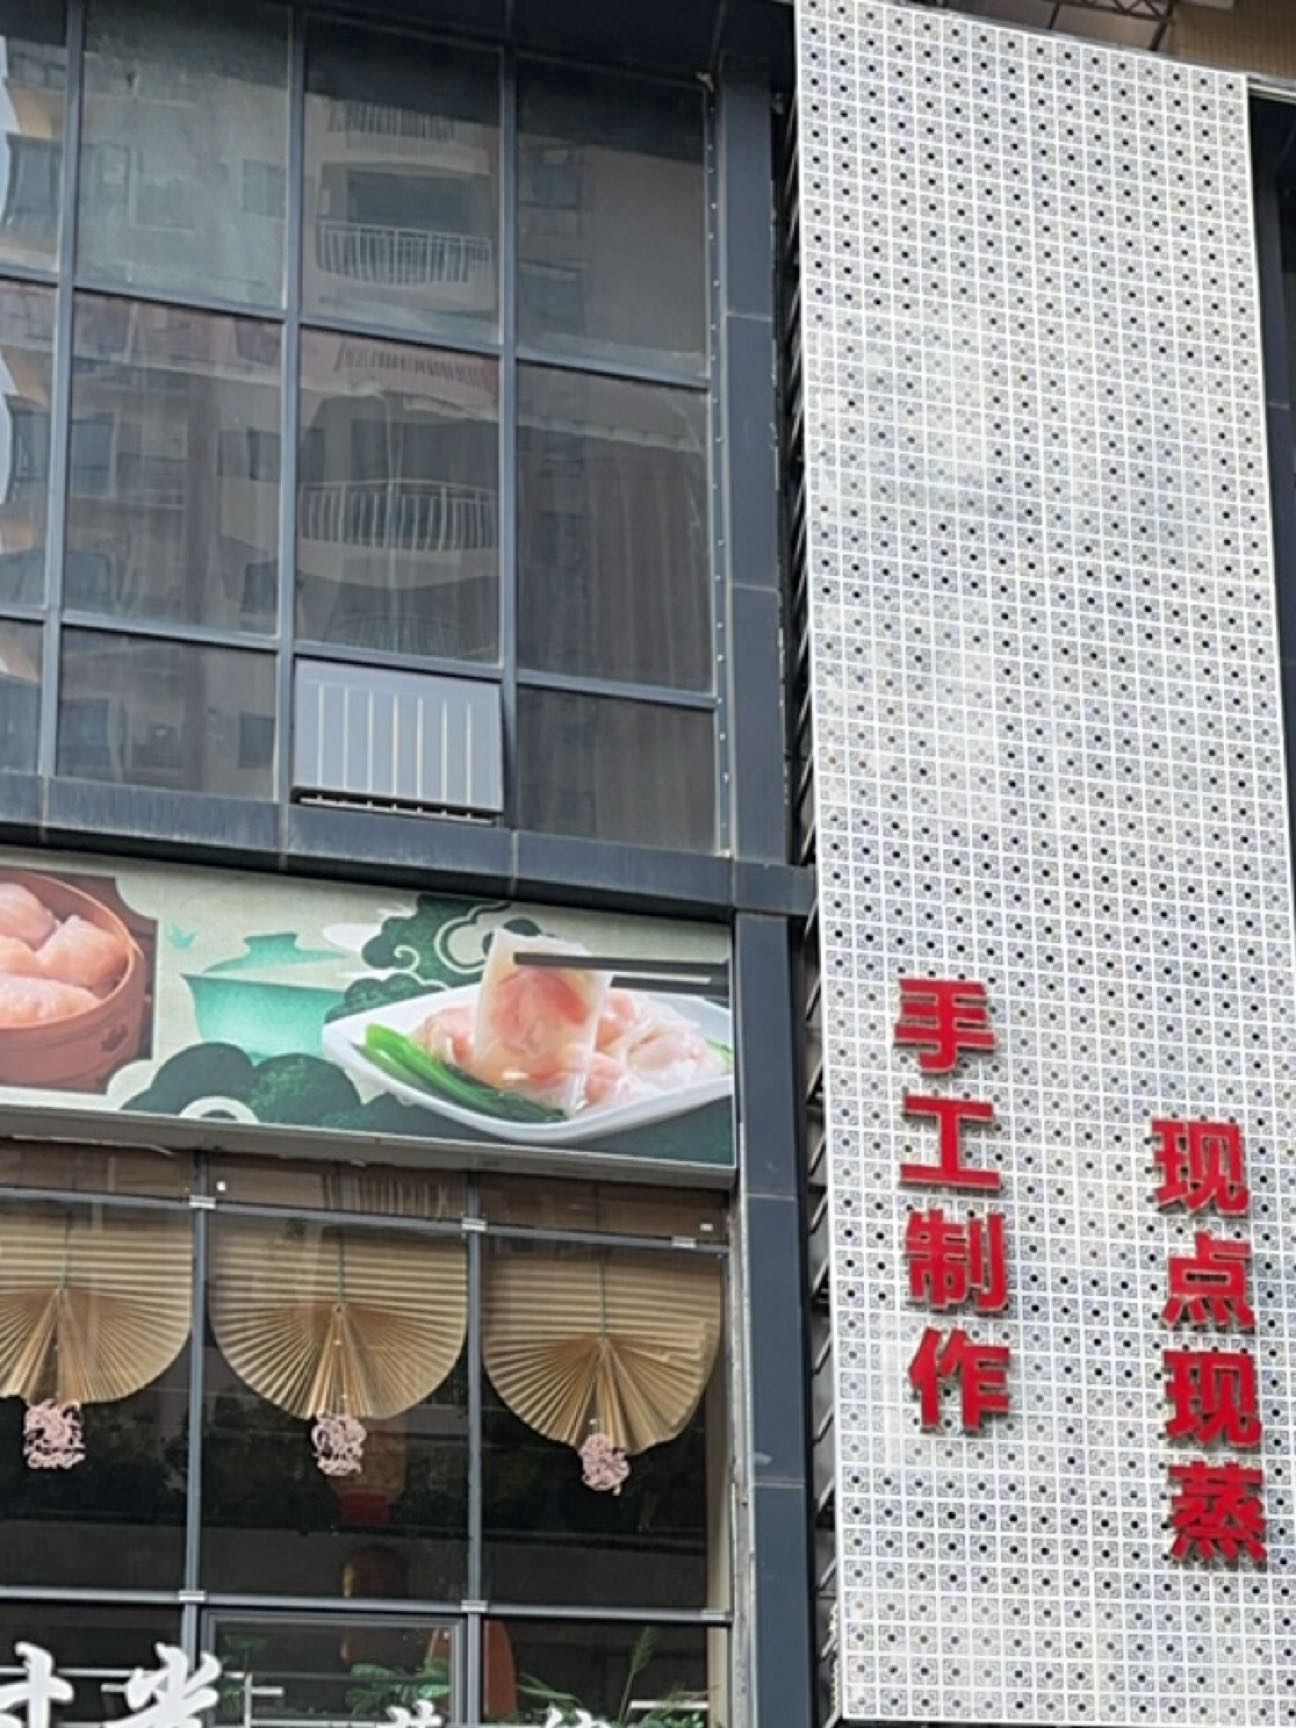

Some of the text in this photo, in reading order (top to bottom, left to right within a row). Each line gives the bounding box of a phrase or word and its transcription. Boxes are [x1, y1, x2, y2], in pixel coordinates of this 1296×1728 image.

[894, 978, 1010, 1435] 手工制作
[1151, 1119, 1267, 1570] 现点现蒸
